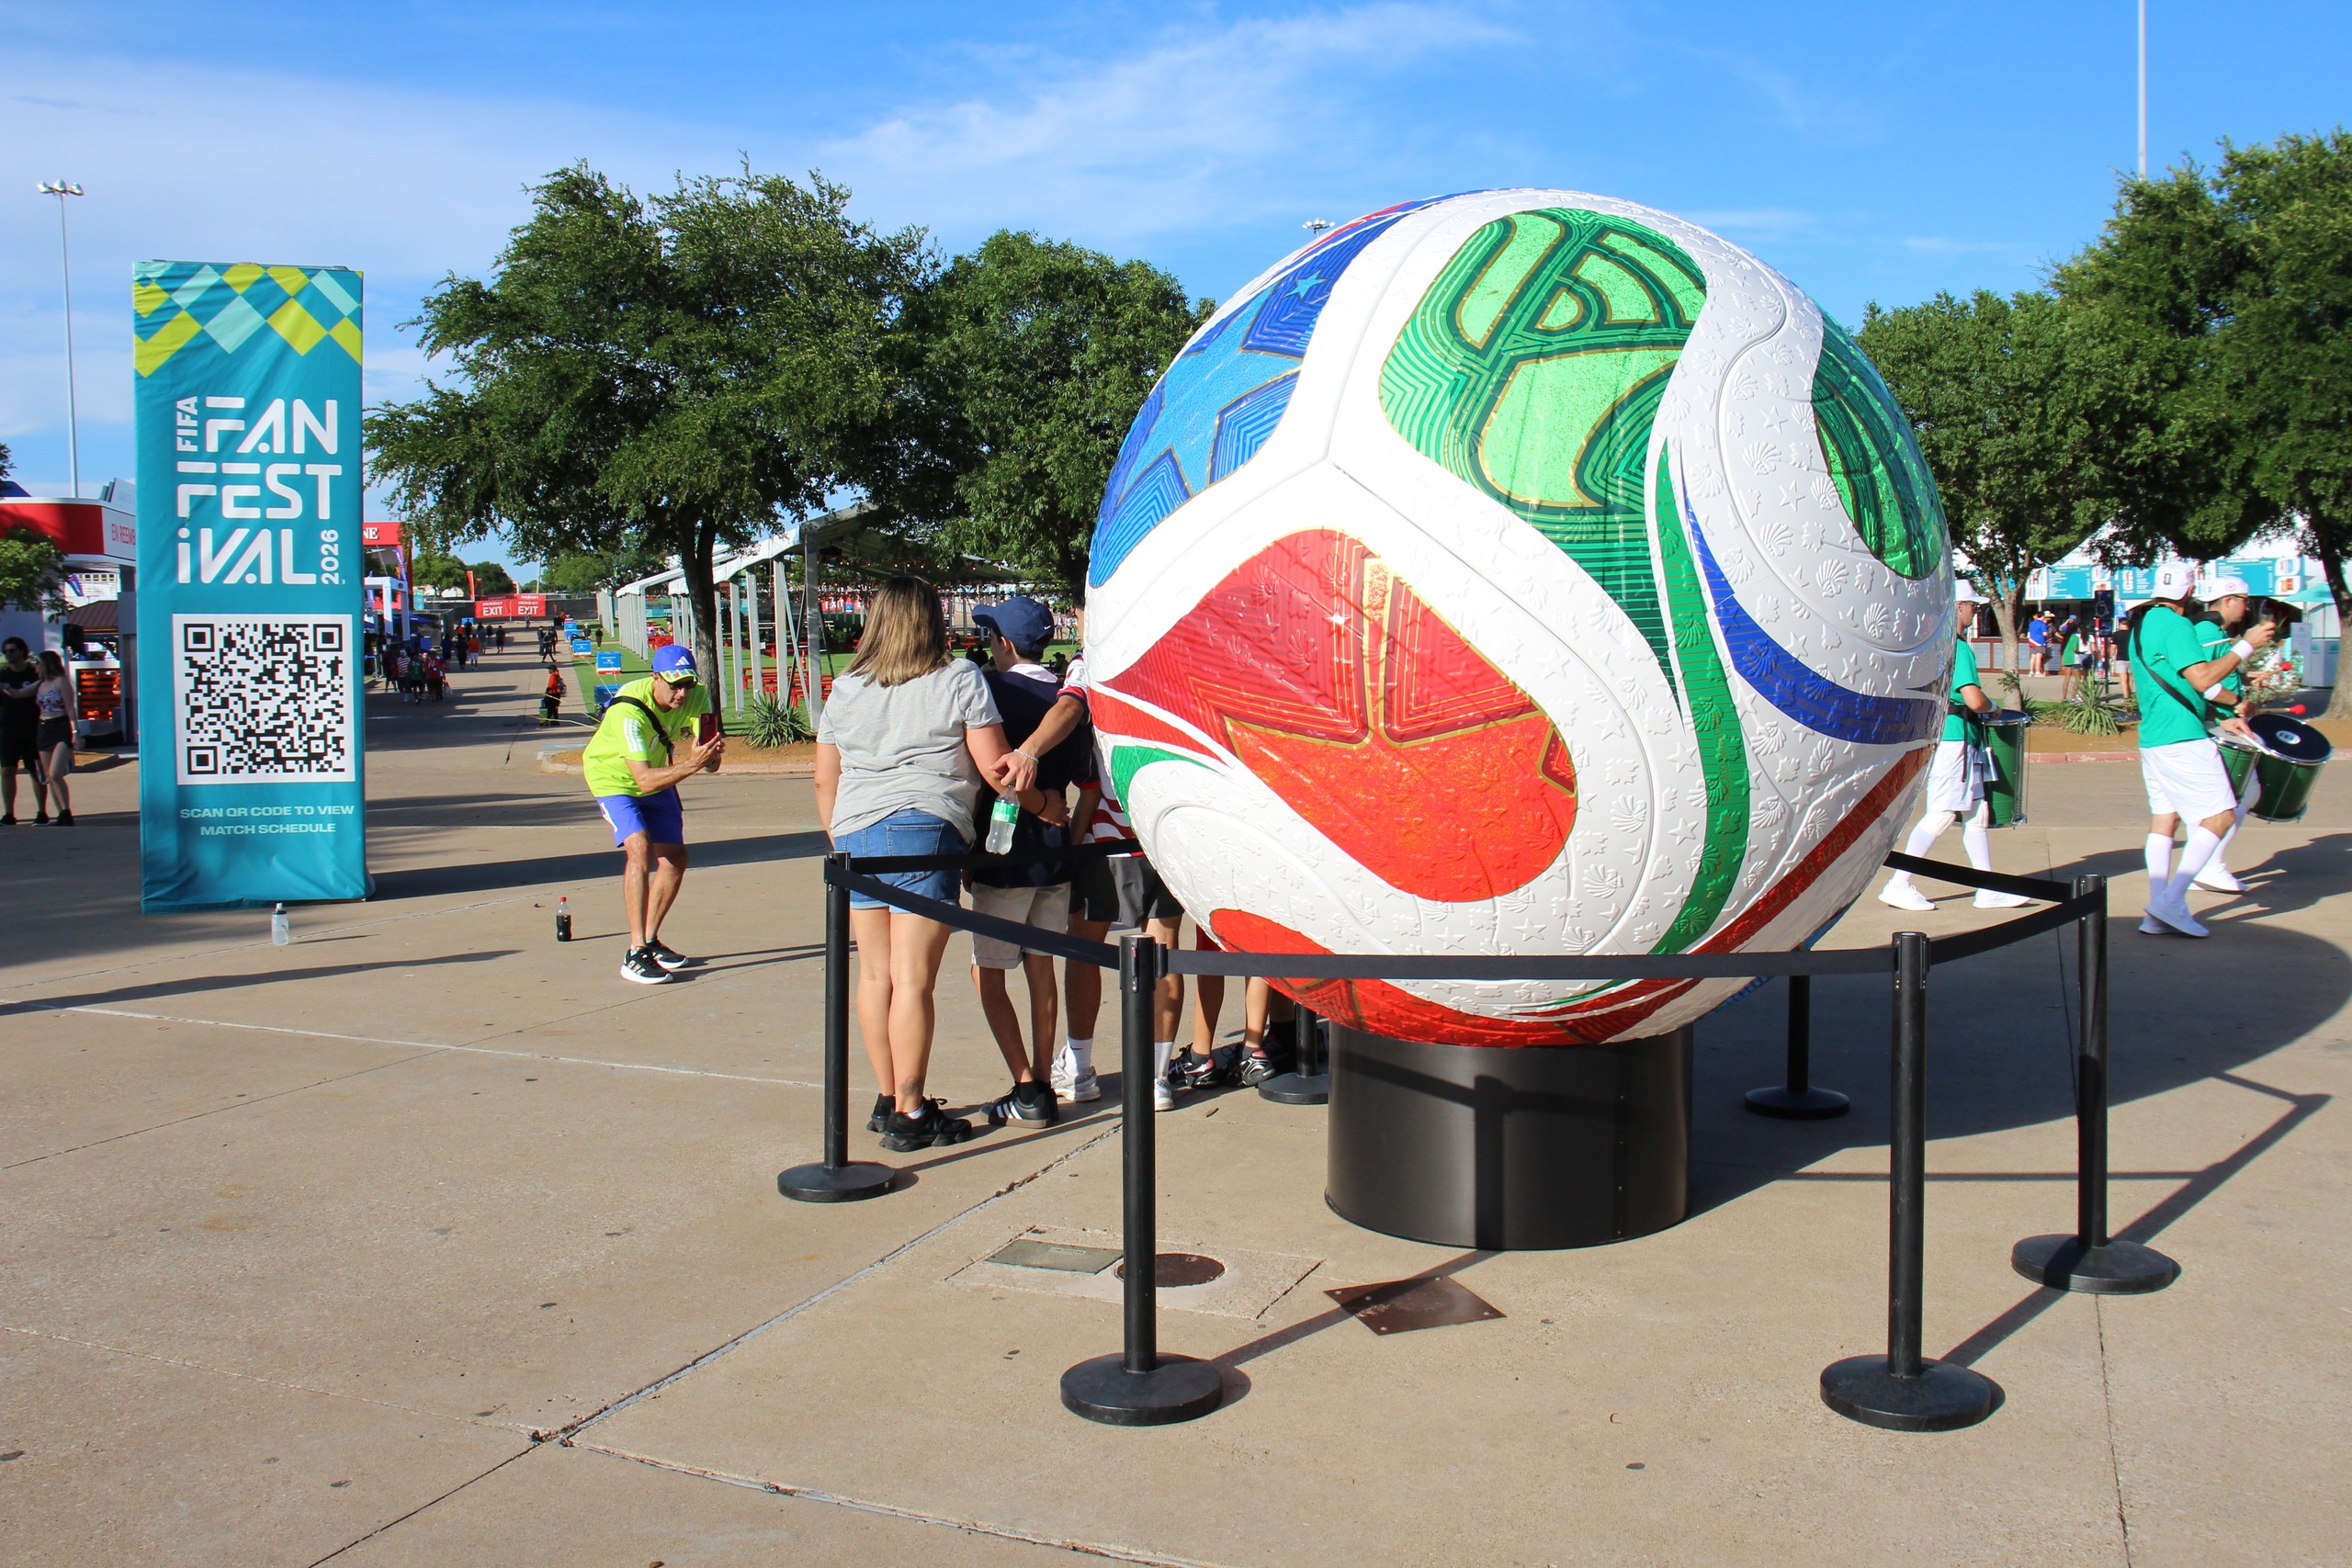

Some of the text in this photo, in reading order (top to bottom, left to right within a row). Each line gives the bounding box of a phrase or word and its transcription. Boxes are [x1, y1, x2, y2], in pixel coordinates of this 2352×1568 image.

[176, 396, 198, 452] FIFA
[205, 396, 338, 455] FAN
[176, 460, 343, 520] FEST
[321, 528, 339, 585] 2026
[483, 606, 503, 615] EXIT
[518, 606, 538, 615] EXIT
[179, 805, 355, 818] SCAN QR CODE TO VIEW
[199, 823, 336, 836] MATCH SCHEDULE
